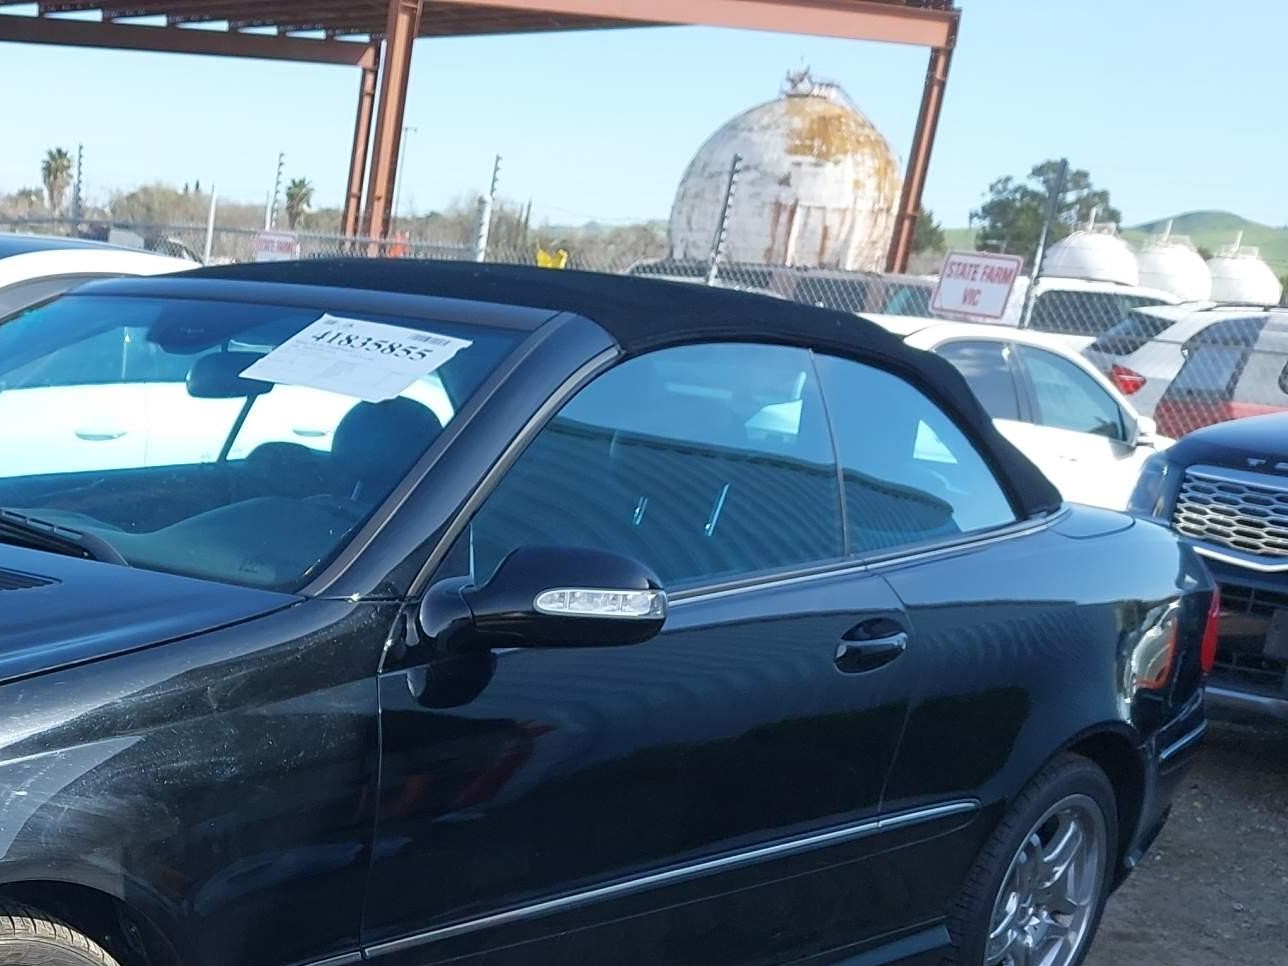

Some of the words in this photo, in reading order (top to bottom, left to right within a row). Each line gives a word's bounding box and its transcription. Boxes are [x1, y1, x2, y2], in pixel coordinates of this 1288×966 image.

[945, 261, 981, 281] STATE
[981, 264, 1015, 284] FARM
[311, 330, 434, 361] 41835855
